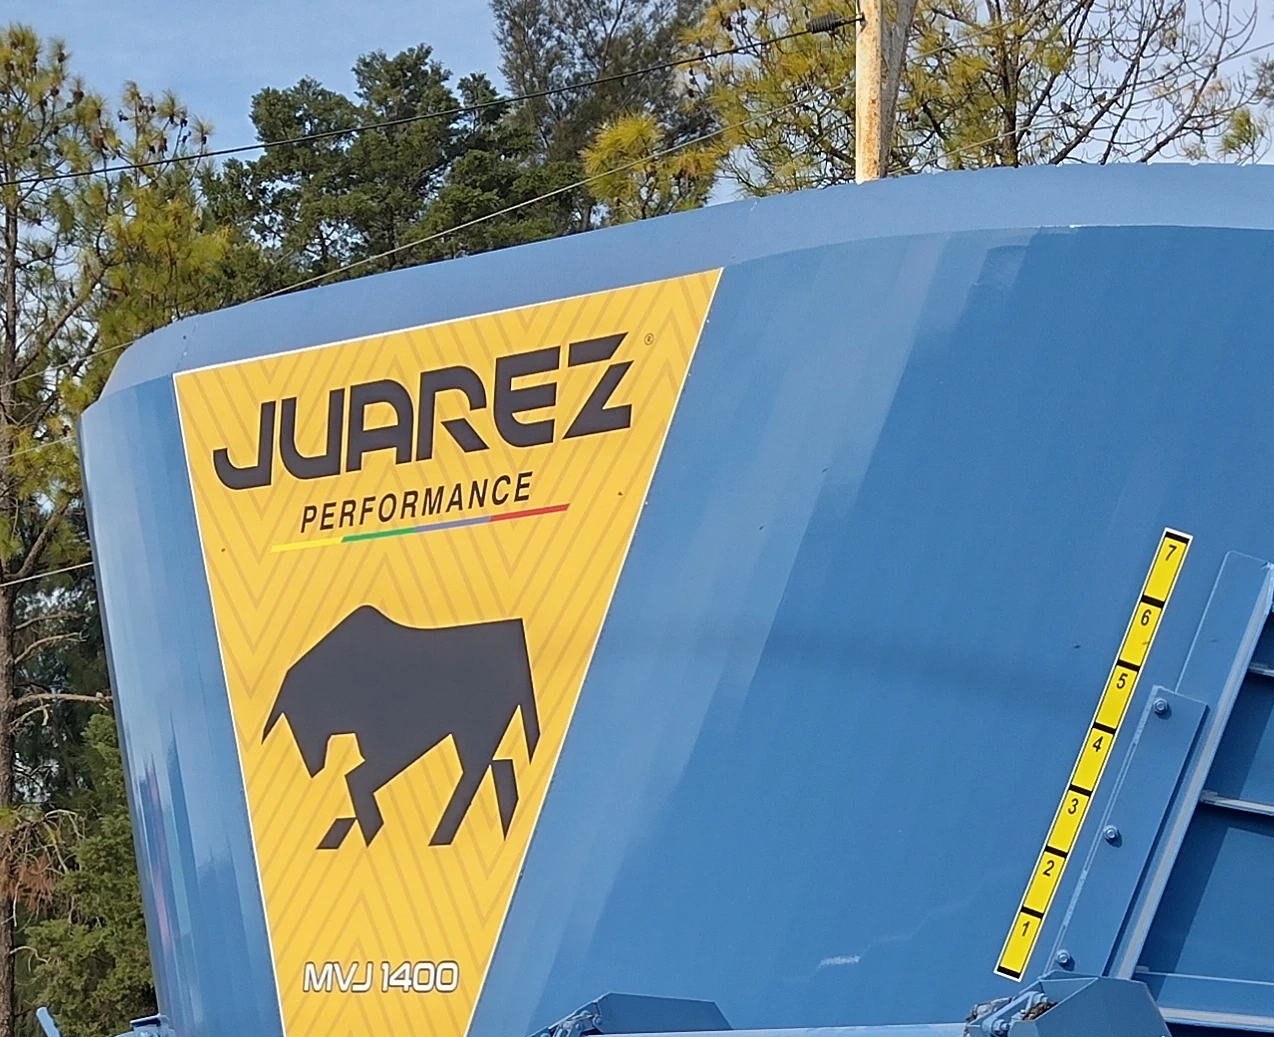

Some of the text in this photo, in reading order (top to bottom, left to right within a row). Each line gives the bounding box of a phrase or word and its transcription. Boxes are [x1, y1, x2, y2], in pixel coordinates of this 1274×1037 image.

[213, 331, 635, 490] JUAREZ
[301, 471, 533, 533] PERFORMANCE
[1165, 545, 1177, 561] 7
[1140, 610, 1152, 626] 6
[1116, 674, 1128, 690] 5
[1092, 737, 1103, 753] 4
[1068, 799, 1079, 815] 3
[1043, 860, 1055, 877] 2
[1021, 922, 1030, 937] 1
[302, 960, 460, 994] MVJ 1400
